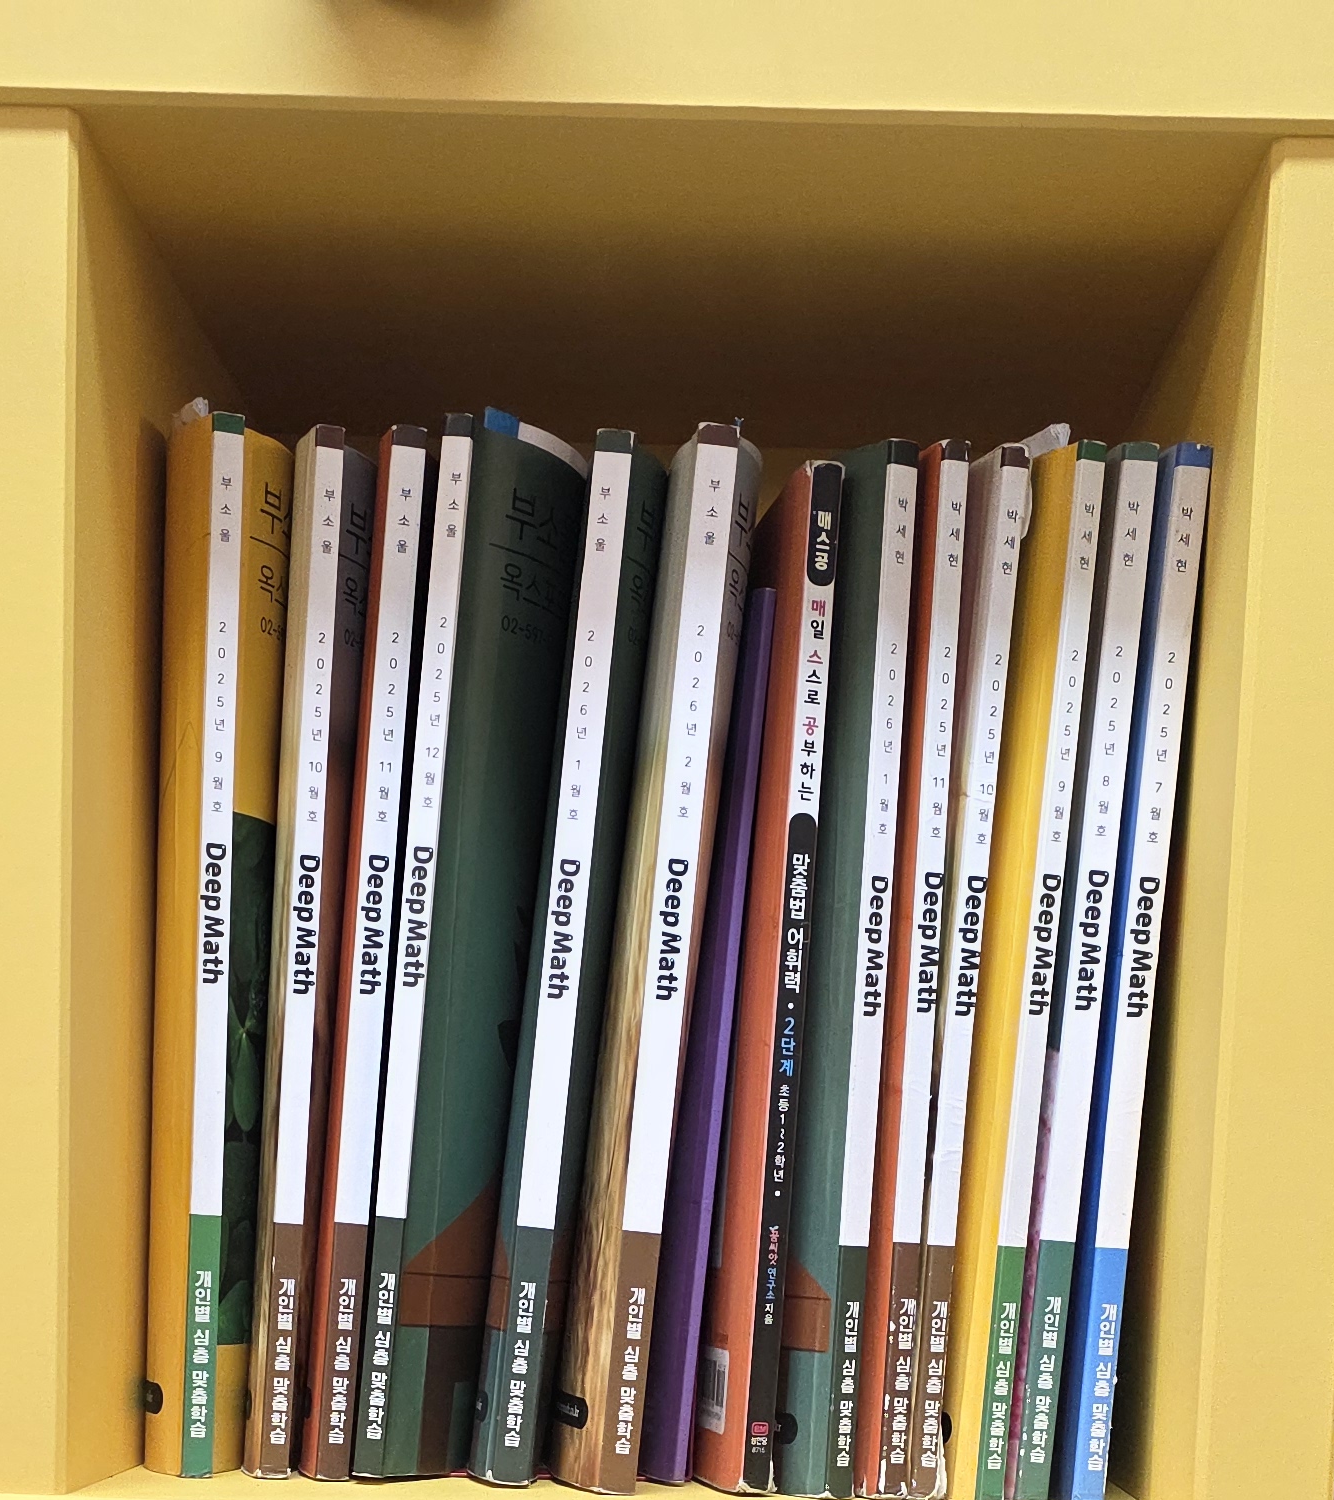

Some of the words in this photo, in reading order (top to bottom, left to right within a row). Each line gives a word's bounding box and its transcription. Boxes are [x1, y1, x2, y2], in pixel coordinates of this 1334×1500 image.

[813, 510, 833, 571] 매스공
[894, 496, 909, 566] 박세현
[1175, 506, 1195, 574] 박세현
[808, 599, 828, 641] 매일
[804, 649, 823, 705] 스스로
[796, 715, 819, 802] 공부하는
[788, 853, 810, 920] 맞춤법
[783, 927, 804, 993] 어휘력
[779, 1017, 796, 1077] 2단계
[516, 1281, 538, 1335] 개인별
[843, 1301, 861, 1354] 개인별
[1097, 1303, 1119, 1357] 개인별
[511, 1338, 531, 1376] 심층
[840, 1358, 857, 1395] 심층
[1093, 1361, 1113, 1399] 심층
[504, 1379, 528, 1449] 맞춤학습
[836, 1400, 855, 1468] 맞춤학습
[1087, 1403, 1110, 1472] 맞춤학습
